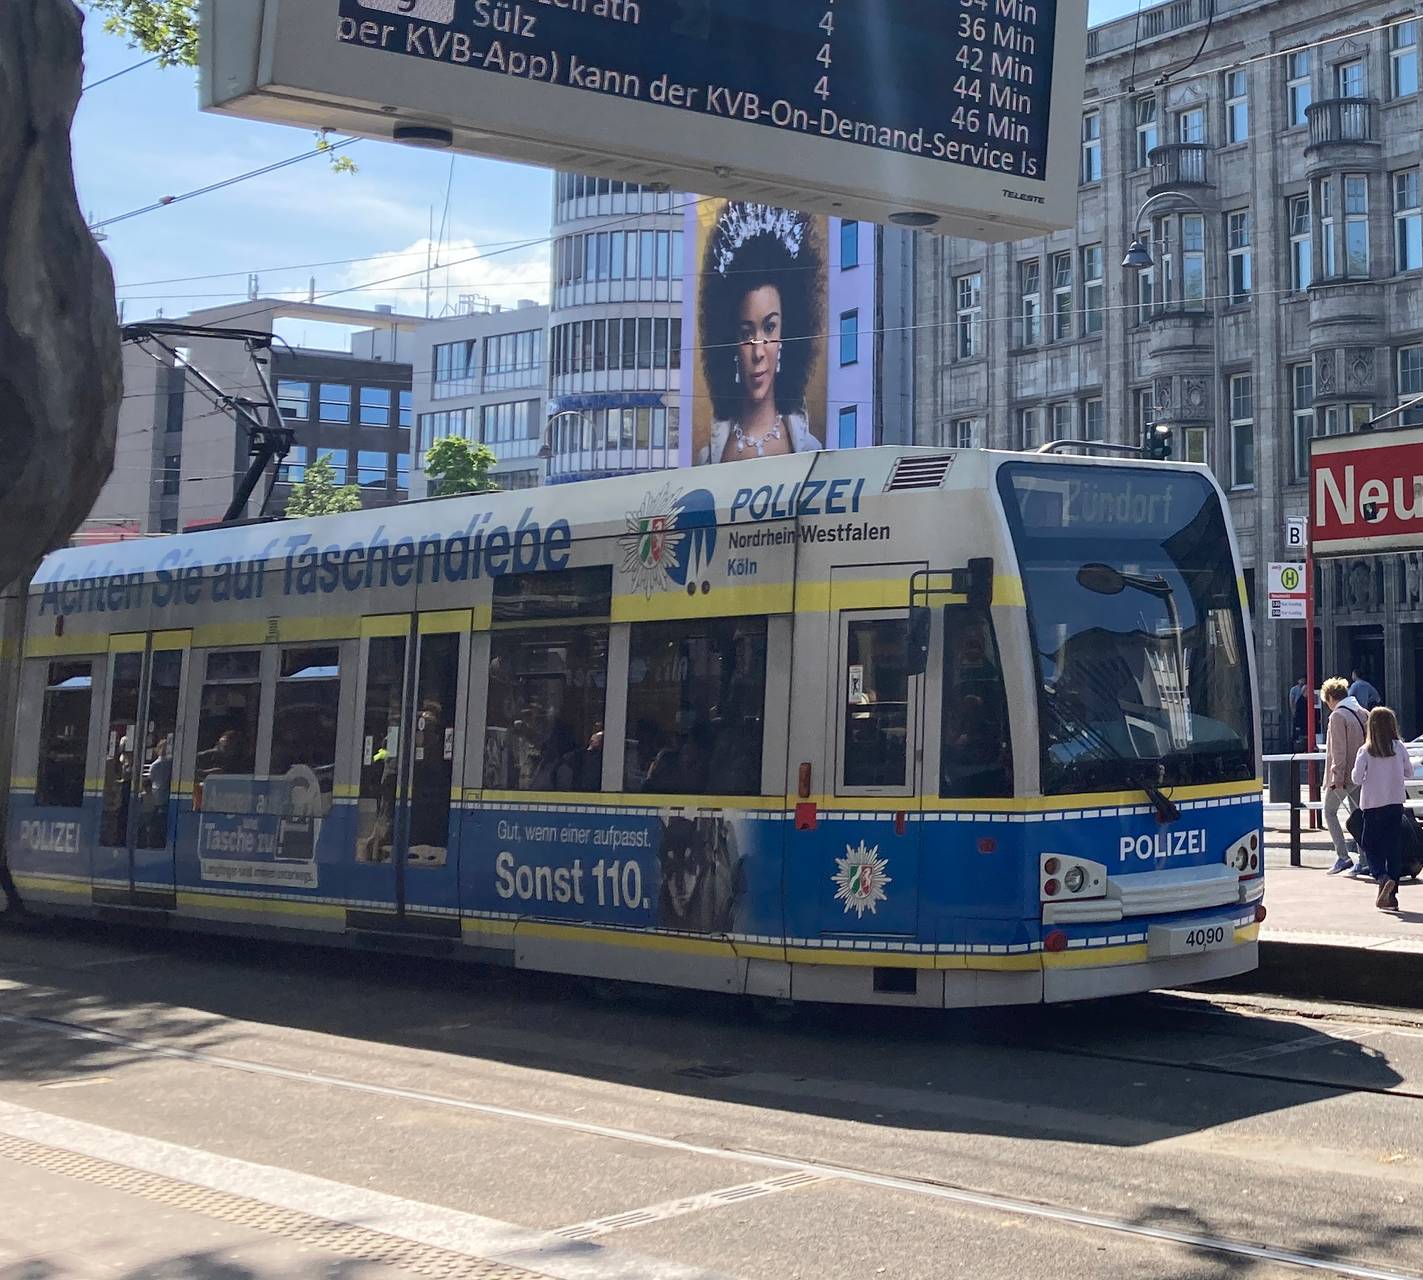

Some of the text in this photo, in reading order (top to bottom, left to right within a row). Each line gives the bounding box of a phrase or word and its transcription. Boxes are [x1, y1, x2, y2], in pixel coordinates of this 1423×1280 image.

[473, 0, 1034, 55] Sülz 4 36 Min
[816, 43, 1033, 85] 4 42 Min
[406, 23, 558, 84] KVB-App)
[569, 55, 640, 97] kann
[650, 75, 697, 108] der
[706, 84, 1014, 172] KVB-On-Demand-Service
[814, 75, 1031, 114] 4 44 Min
[951, 106, 1029, 144] 46 Min
[1002, 189, 1045, 204] TELESTE
[730, 478, 866, 522] POLIZEI
[729, 522, 890, 549] Nordrhein-Westfalen
[1290, 527, 1300, 544] B
[38, 507, 571, 616] Achten Sie auf Taschendiebe
[727, 557, 758, 577] Köln
[1285, 571, 1295, 586] H
[20, 820, 81, 853] POLIZEI
[204, 823, 255, 852] Tasche
[497, 820, 651, 851] Gut, wenn einer aufpasst.
[1120, 828, 1206, 862] POLIZEI
[495, 851, 650, 909] Sonst 110.
[1185, 926, 1224, 947] 4090
